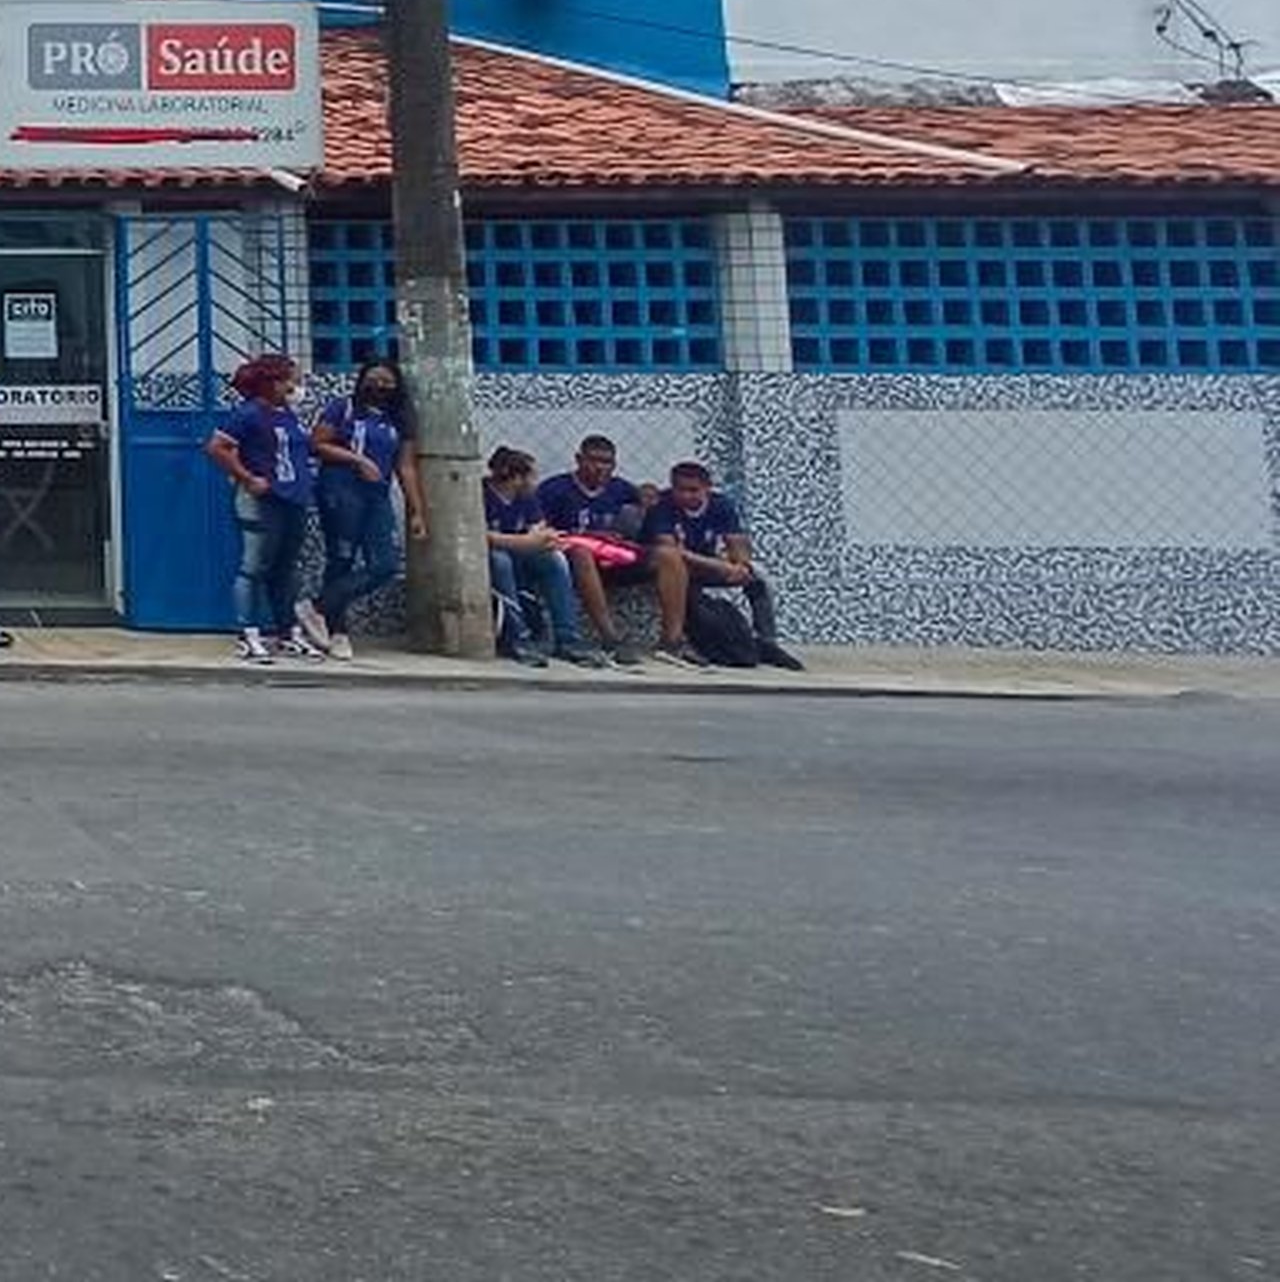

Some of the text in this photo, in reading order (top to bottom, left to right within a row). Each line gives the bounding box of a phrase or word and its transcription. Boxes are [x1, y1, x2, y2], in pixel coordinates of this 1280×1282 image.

[43, 29, 291, 76] PRÓ Saúde
[52, 95, 270, 116] MEDICINA LABORATORIAL
